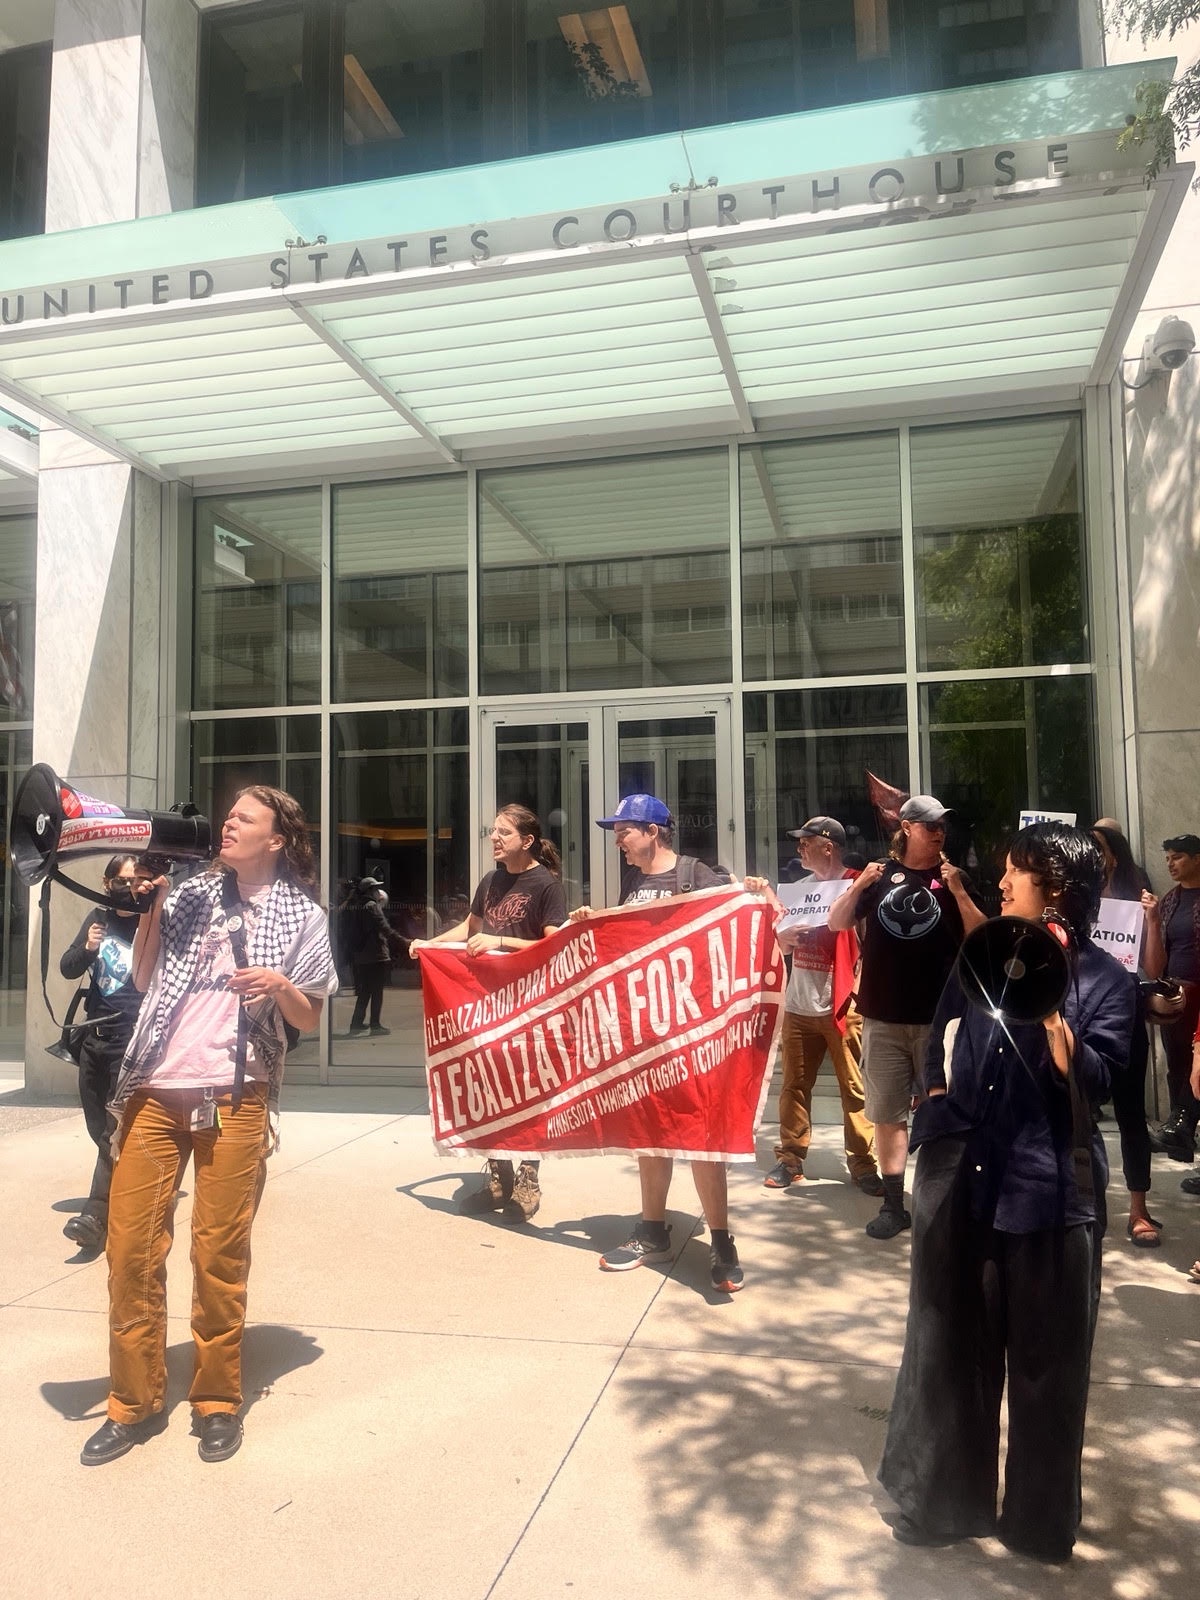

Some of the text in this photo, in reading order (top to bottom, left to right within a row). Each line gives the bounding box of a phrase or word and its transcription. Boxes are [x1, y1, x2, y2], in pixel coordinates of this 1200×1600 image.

[1, 143, 1069, 324] UNITED STATES COURTHOUSE
[89, 828, 102, 838] LA
[637, 889, 658, 900] ONE
[660, 890, 673, 900] IS
[804, 893, 822, 903] NO
[783, 905, 831, 916] OOPERATI
[1091, 929, 1137, 944] ATION
[516, 963, 547, 1009] PARA
[432, 910, 780, 1134] LEGALIZATION FOR ALL!
[547, 1098, 598, 1140] MINNESOTA
[598, 1068, 650, 1116] IMMIGRANT
[650, 1054, 689, 1093] RIGHTS
[690, 1034, 725, 1076] ACTION
